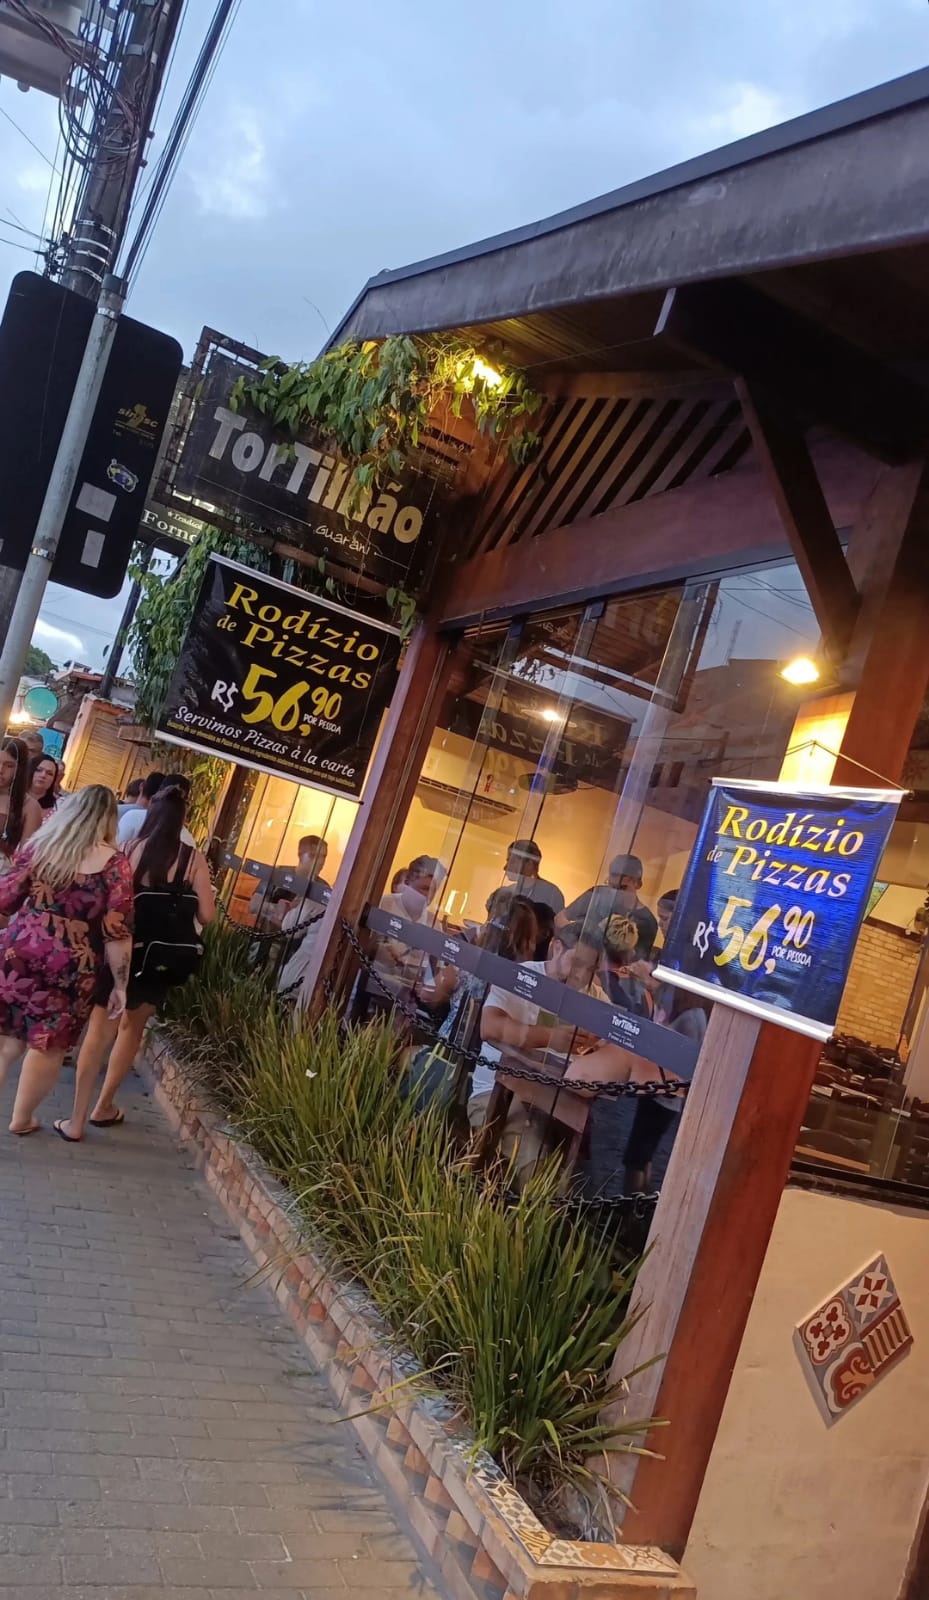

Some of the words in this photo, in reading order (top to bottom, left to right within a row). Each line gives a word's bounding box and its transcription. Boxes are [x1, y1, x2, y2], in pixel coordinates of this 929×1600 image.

[224, 581, 379, 661] Rodízio
[216, 614, 238, 632] de
[240, 621, 372, 689] Pizzas
[211, 679, 239, 712] R$
[175, 706, 243, 739] Servimos
[243, 729, 289, 755] Pizzas
[290, 745, 301, 760] à
[303, 749, 318, 766] la
[320, 759, 356, 777] carte
[303, 713, 317, 725] POR
[318, 718, 342, 735] PESSOA
[715, 805, 864, 856] Rodízio
[706, 845, 722, 863] de
[723, 844, 852, 898] Pizzas
[693, 921, 714, 958] R$
[771, 946, 786, 959] POR
[786, 949, 812, 967] PESSOA
